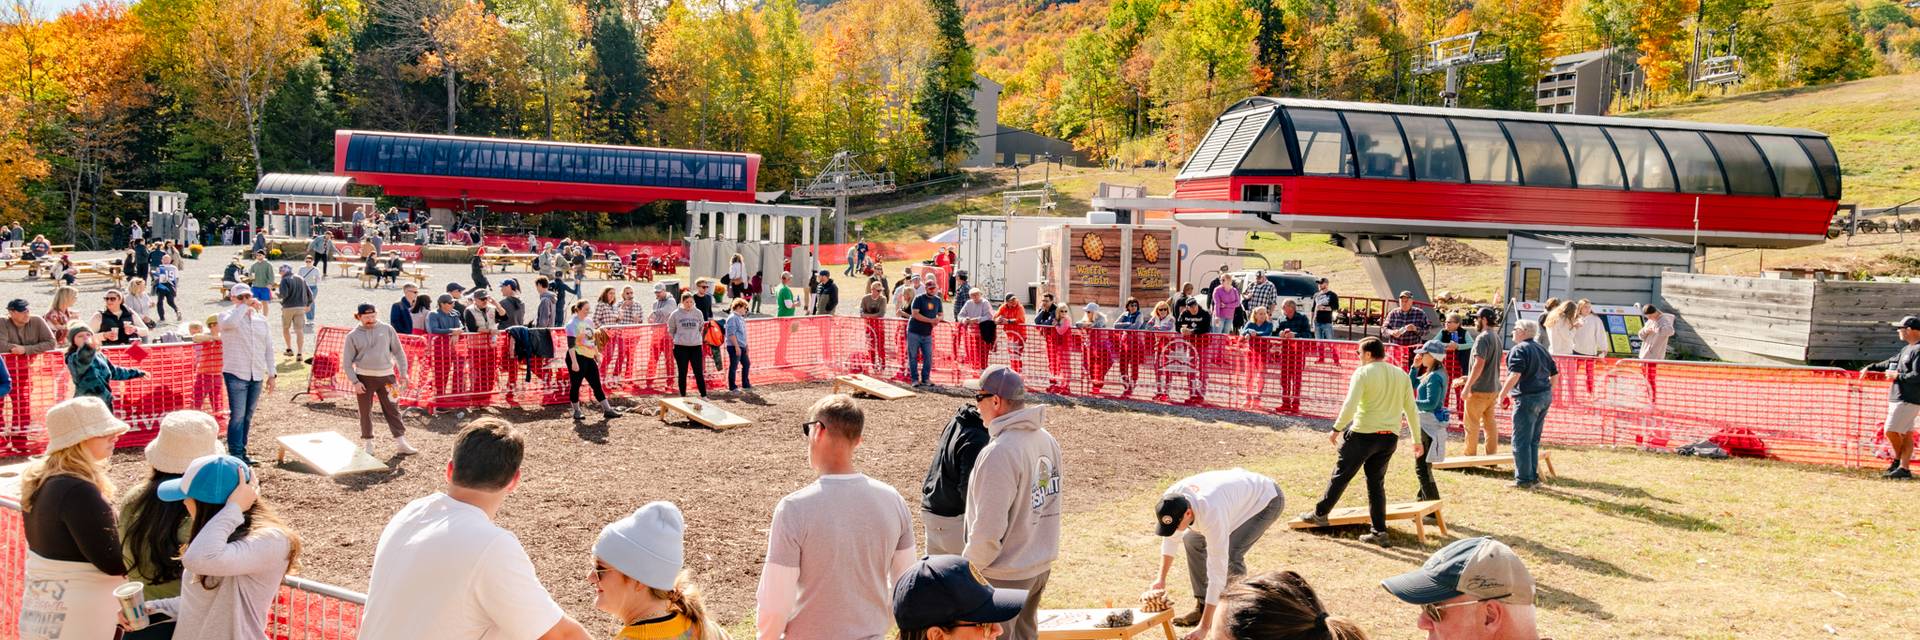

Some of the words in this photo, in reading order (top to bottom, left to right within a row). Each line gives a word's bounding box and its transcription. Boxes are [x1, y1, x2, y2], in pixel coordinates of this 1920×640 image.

[1076, 265, 1108, 275] Waffle
[1136, 266, 1162, 278] Waffle
[164, 270, 175, 281] 19
[1080, 276, 1110, 286] Cabin
[1142, 279, 1164, 289] Cabin
[113, 406, 167, 432] Riv
